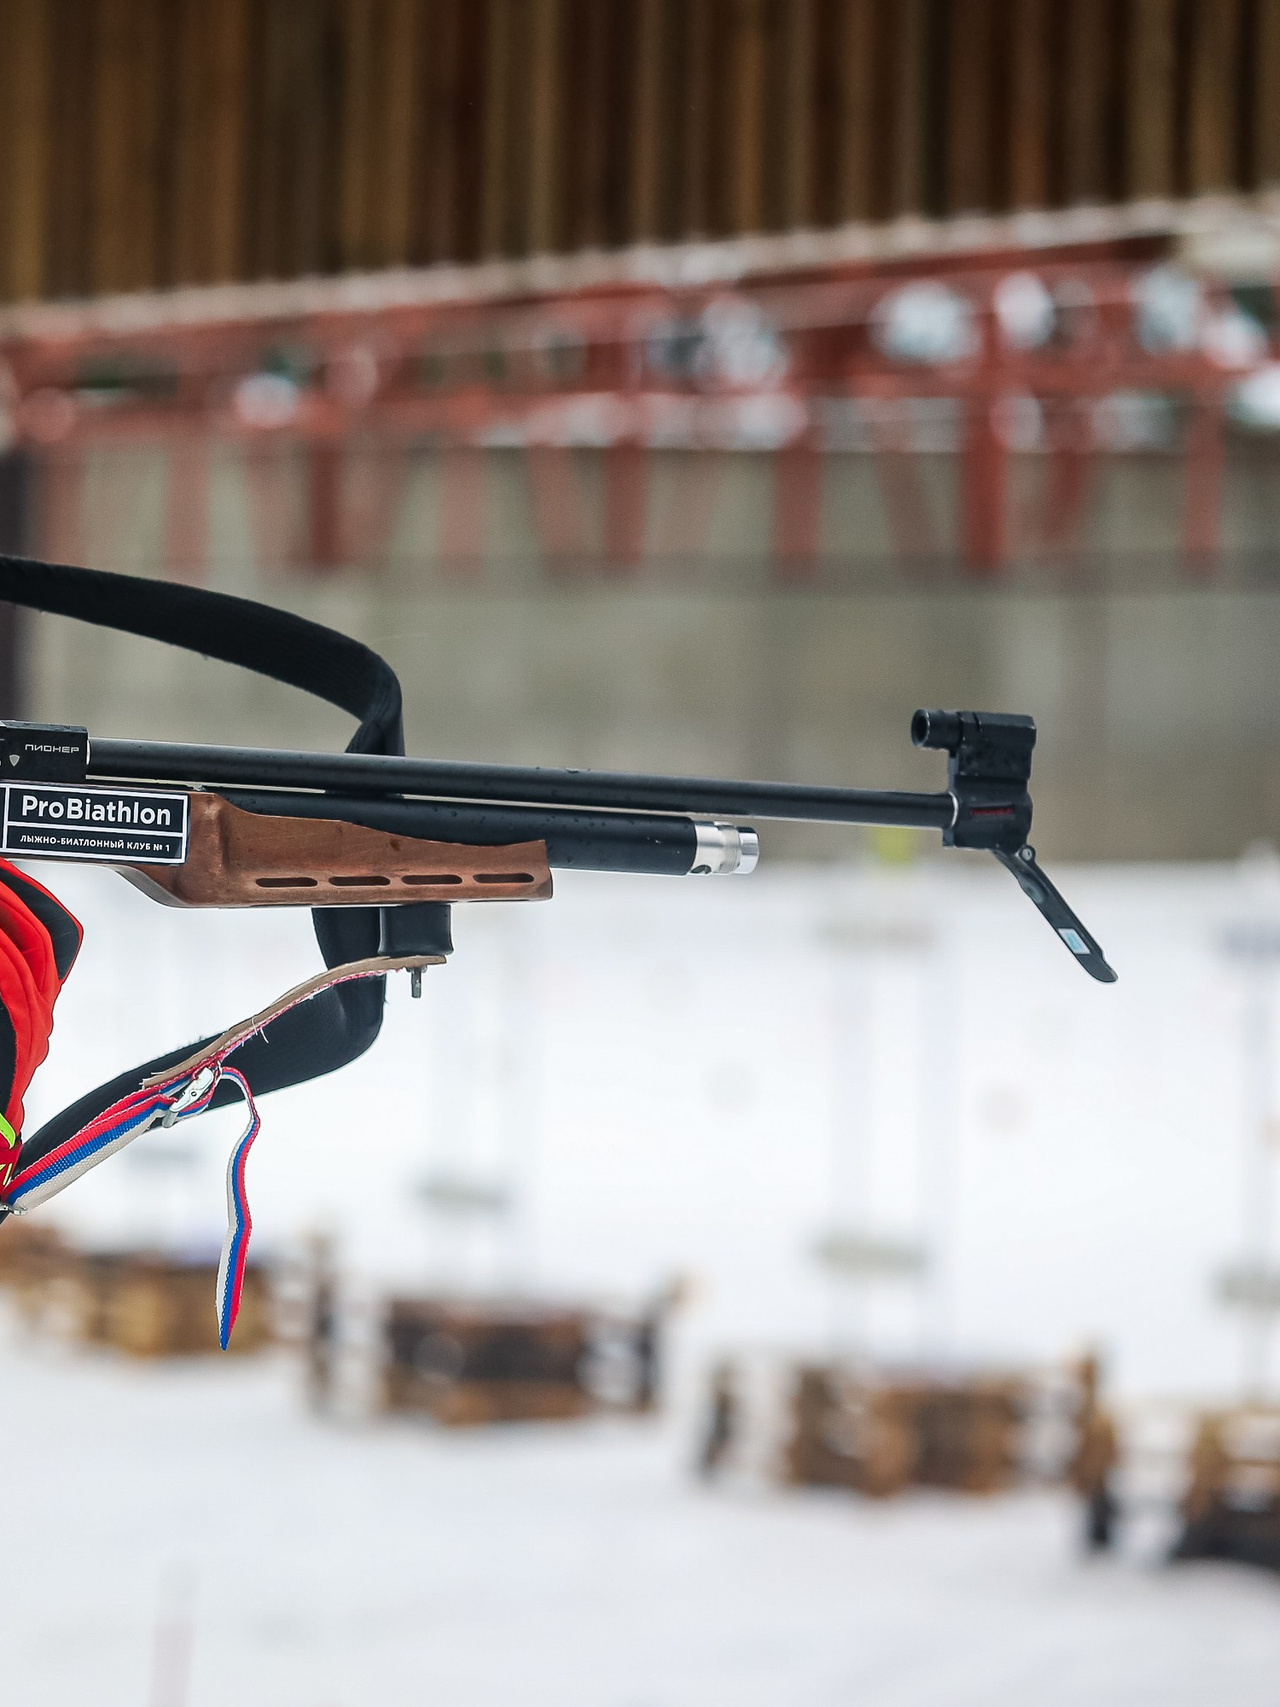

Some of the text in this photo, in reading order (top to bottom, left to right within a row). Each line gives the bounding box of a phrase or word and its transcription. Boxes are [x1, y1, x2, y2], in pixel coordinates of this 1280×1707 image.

[24, 744, 80, 753] ПИОНЕР
[21, 795, 171, 826] ProBiathlon
[20, 834, 124, 849] ЛЫЖНО-БИАТЛОННЫЙ
[127, 841, 151, 851] КЛУБ
[165, 844, 170, 852] 1
